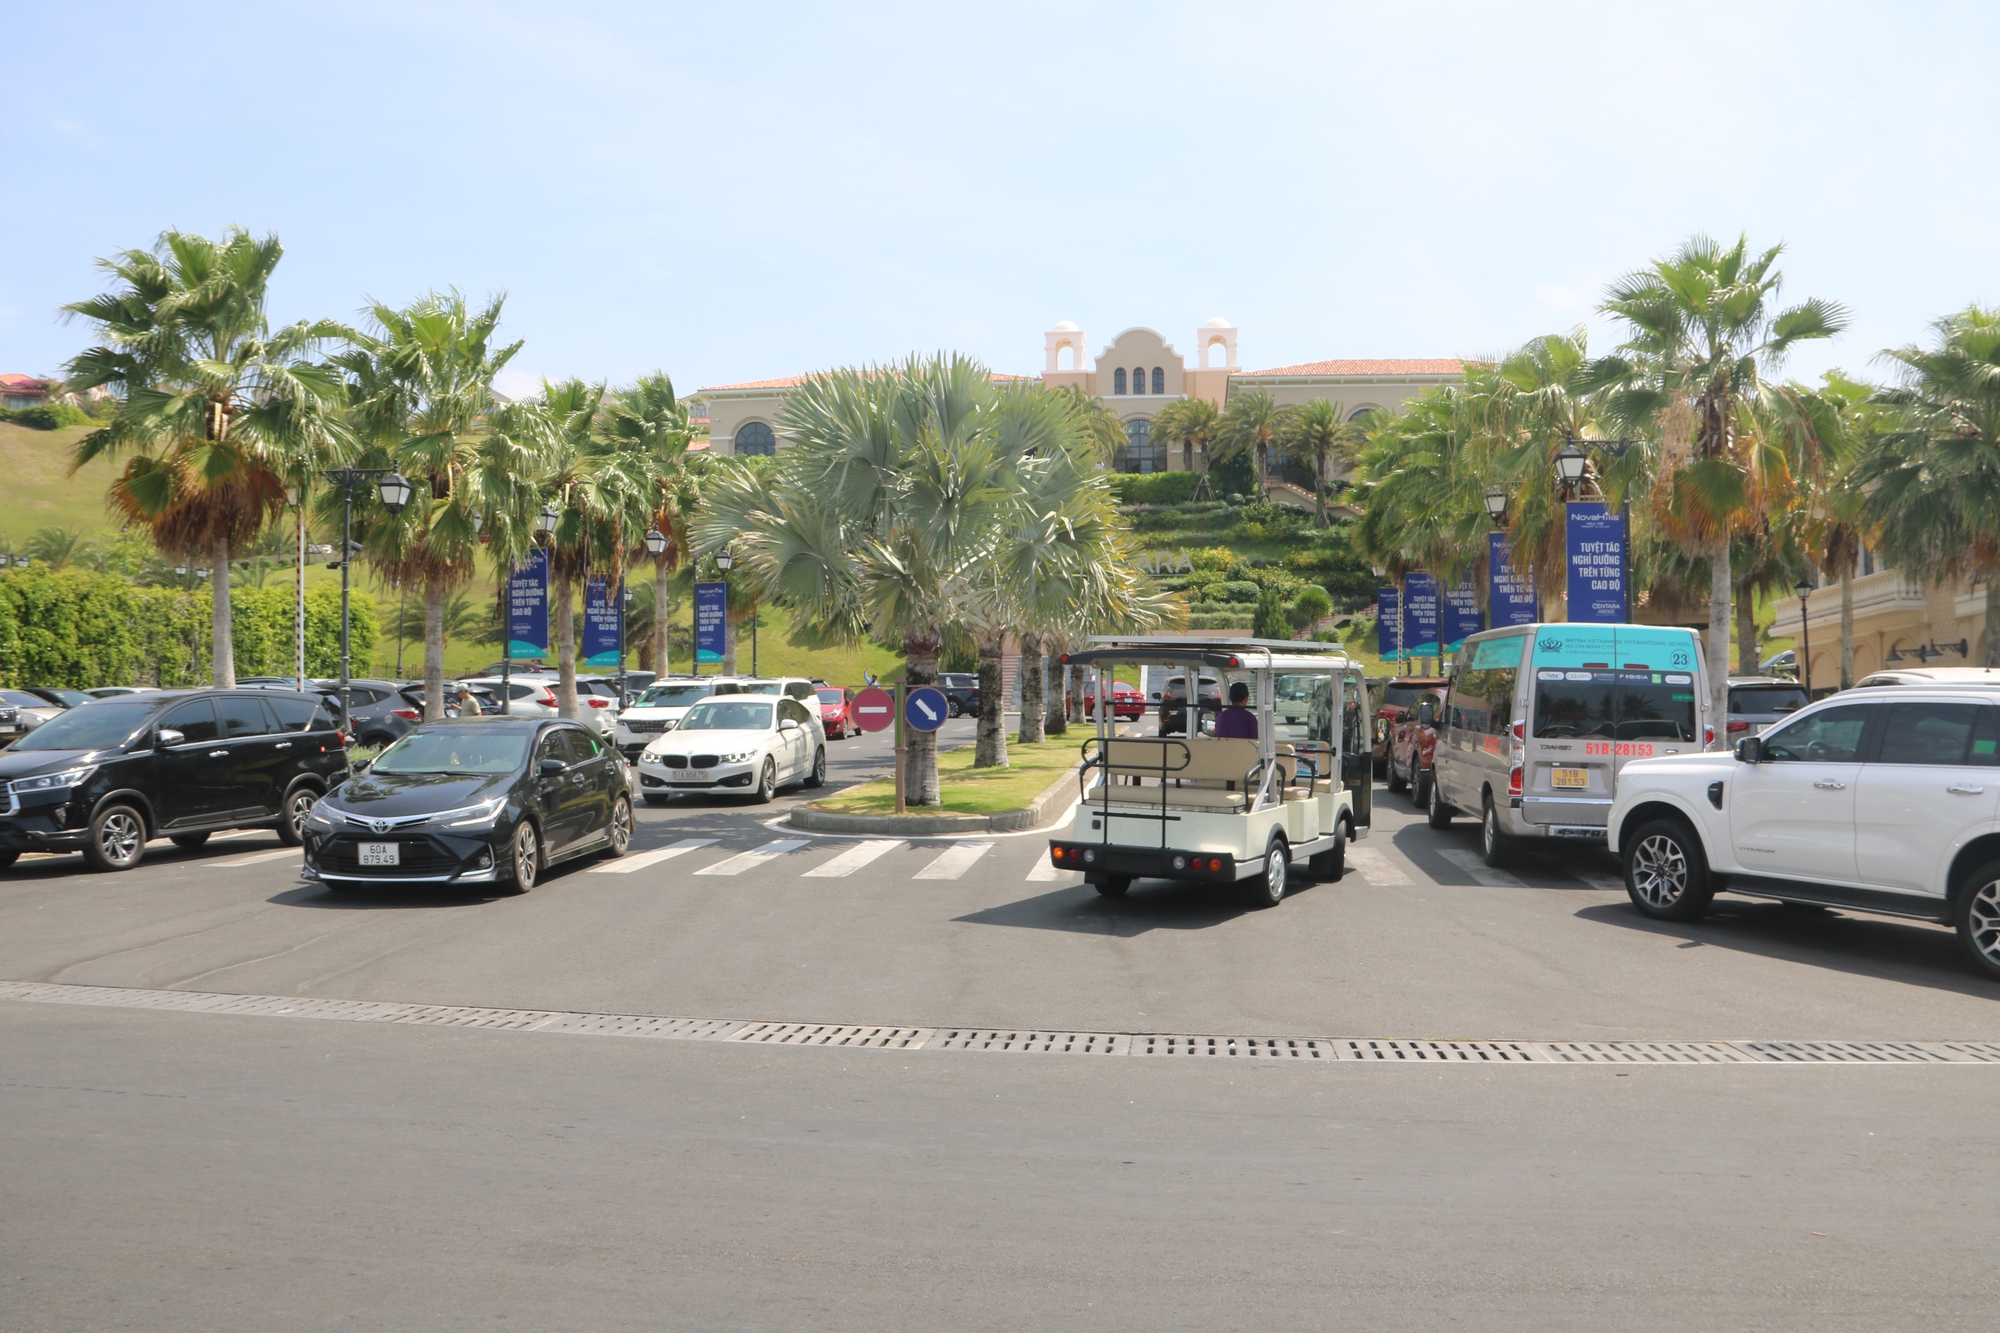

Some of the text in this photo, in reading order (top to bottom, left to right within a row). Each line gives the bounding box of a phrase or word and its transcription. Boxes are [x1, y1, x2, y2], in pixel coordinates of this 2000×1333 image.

[1580, 541, 1620, 554] TUYỆT TÁC
[1572, 553, 1620, 565] NGHỈ DƯỠNG
[1579, 566, 1620, 578] TRÊN TỪNG
[1592, 579, 1620, 591] CAO ĐỘ
[1510, 595, 1522, 603] CAO
[1673, 654, 1688, 665] 23
[1586, 742, 1653, 756] 51B-28153
[1556, 778, 1585, 786] 281.53
[370, 845, 387, 854] 60A
[363, 855, 394, 864] 879.49
